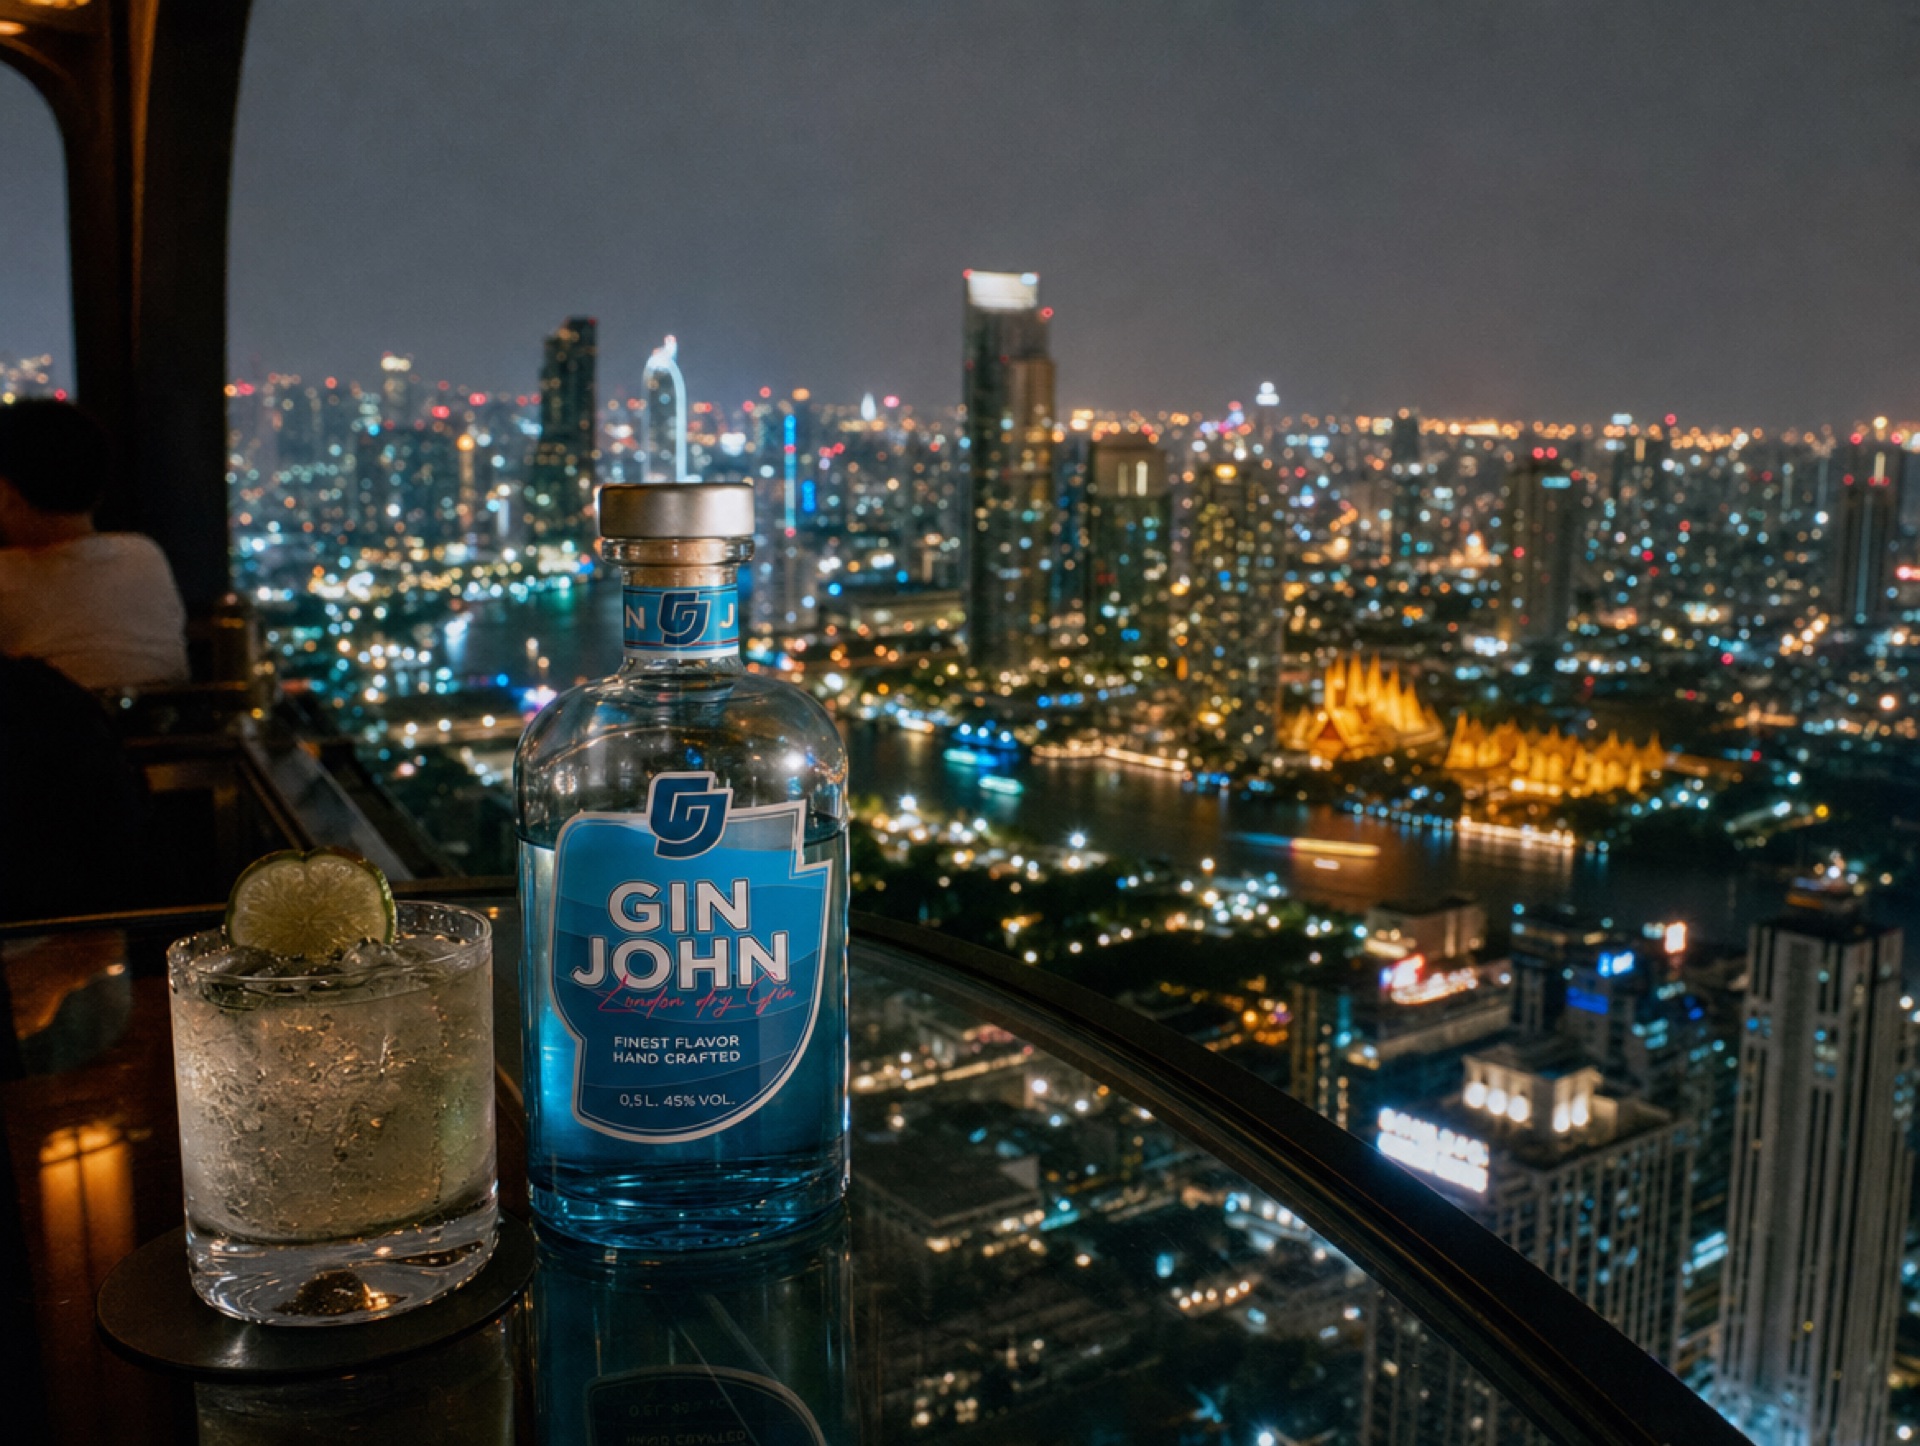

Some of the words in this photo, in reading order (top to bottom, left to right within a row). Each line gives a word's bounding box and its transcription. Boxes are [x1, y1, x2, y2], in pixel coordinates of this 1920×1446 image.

[608, 878, 749, 933] GIN
[571, 931, 789, 990] JOHN
[598, 973, 685, 1020] London
[694, 985, 746, 1019] dry
[746, 971, 796, 1016] Gin
[613, 1051, 659, 1064] HAND
[664, 1050, 741, 1064] CRAFTED
[614, 1036, 670, 1049] FINEST
[675, 1034, 740, 1049] FLAVOR
[663, 1094, 696, 1107] 45%
